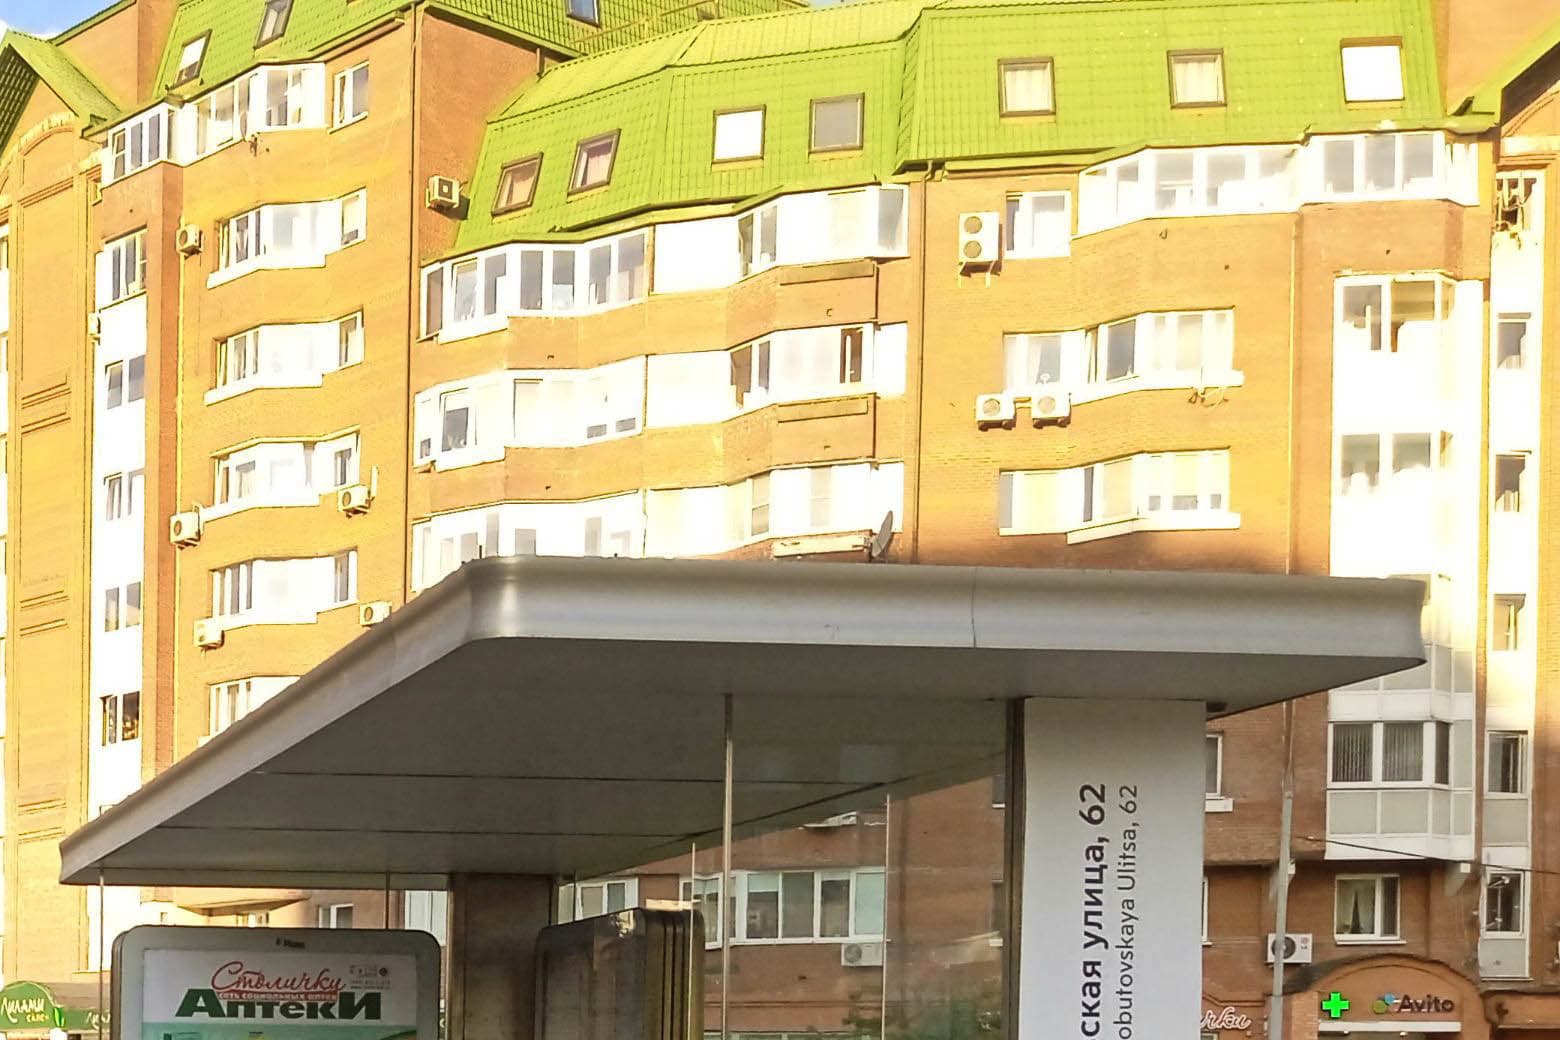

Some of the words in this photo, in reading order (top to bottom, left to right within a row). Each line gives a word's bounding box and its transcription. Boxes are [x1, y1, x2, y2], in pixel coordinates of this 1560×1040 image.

[1079, 783, 1106, 826] 62
[1119, 785, 1137, 815] 62
[1117, 821, 1139, 892] Ulitsa,
[1082, 836, 1110, 950] улица,
[211, 961, 346, 991] Столички
[1399, 994, 1455, 1013] Avito
